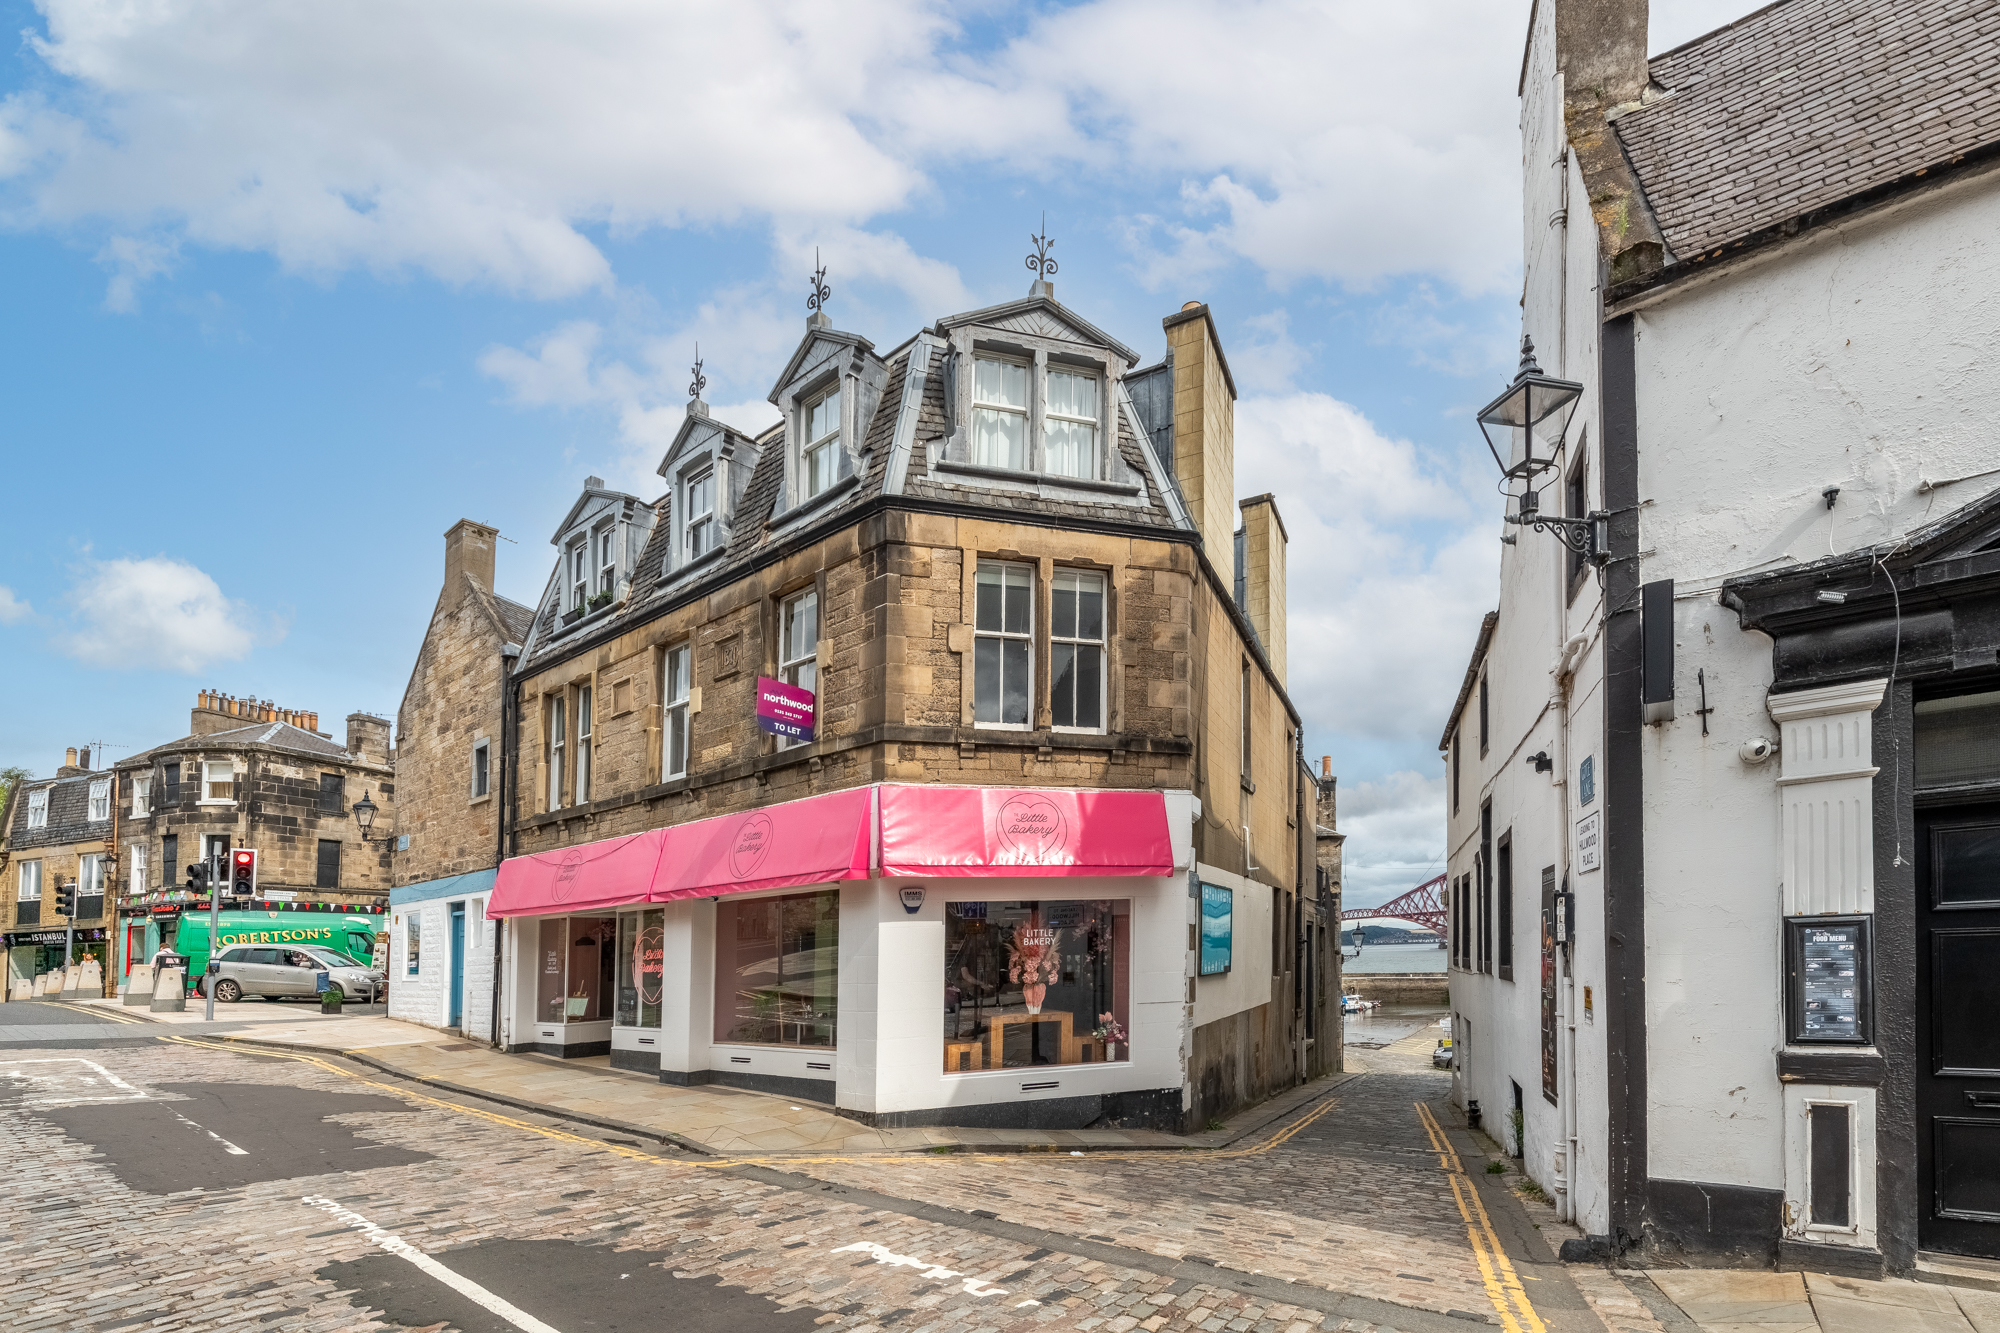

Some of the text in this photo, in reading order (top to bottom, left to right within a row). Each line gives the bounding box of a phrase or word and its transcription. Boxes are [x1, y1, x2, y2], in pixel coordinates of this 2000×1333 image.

[764, 693, 814, 713] northwood
[774, 723, 801, 735] TO LET
[1581, 780, 1592, 799] LANE
[1016, 813, 1048, 822] Little
[1008, 824, 1052, 838] Bakery
[1580, 823, 1591, 835] LEADING
[743, 831, 763, 842] Little
[1579, 833, 1597, 851] HILLWOOD
[736, 842, 763, 854] Bakery
[1582, 852, 1594, 867] PLACE
[31, 932, 67, 942] ISTANBUL
[1026, 929, 1054, 937] LITTLE
[1023, 937, 1056, 946] BAKERY
